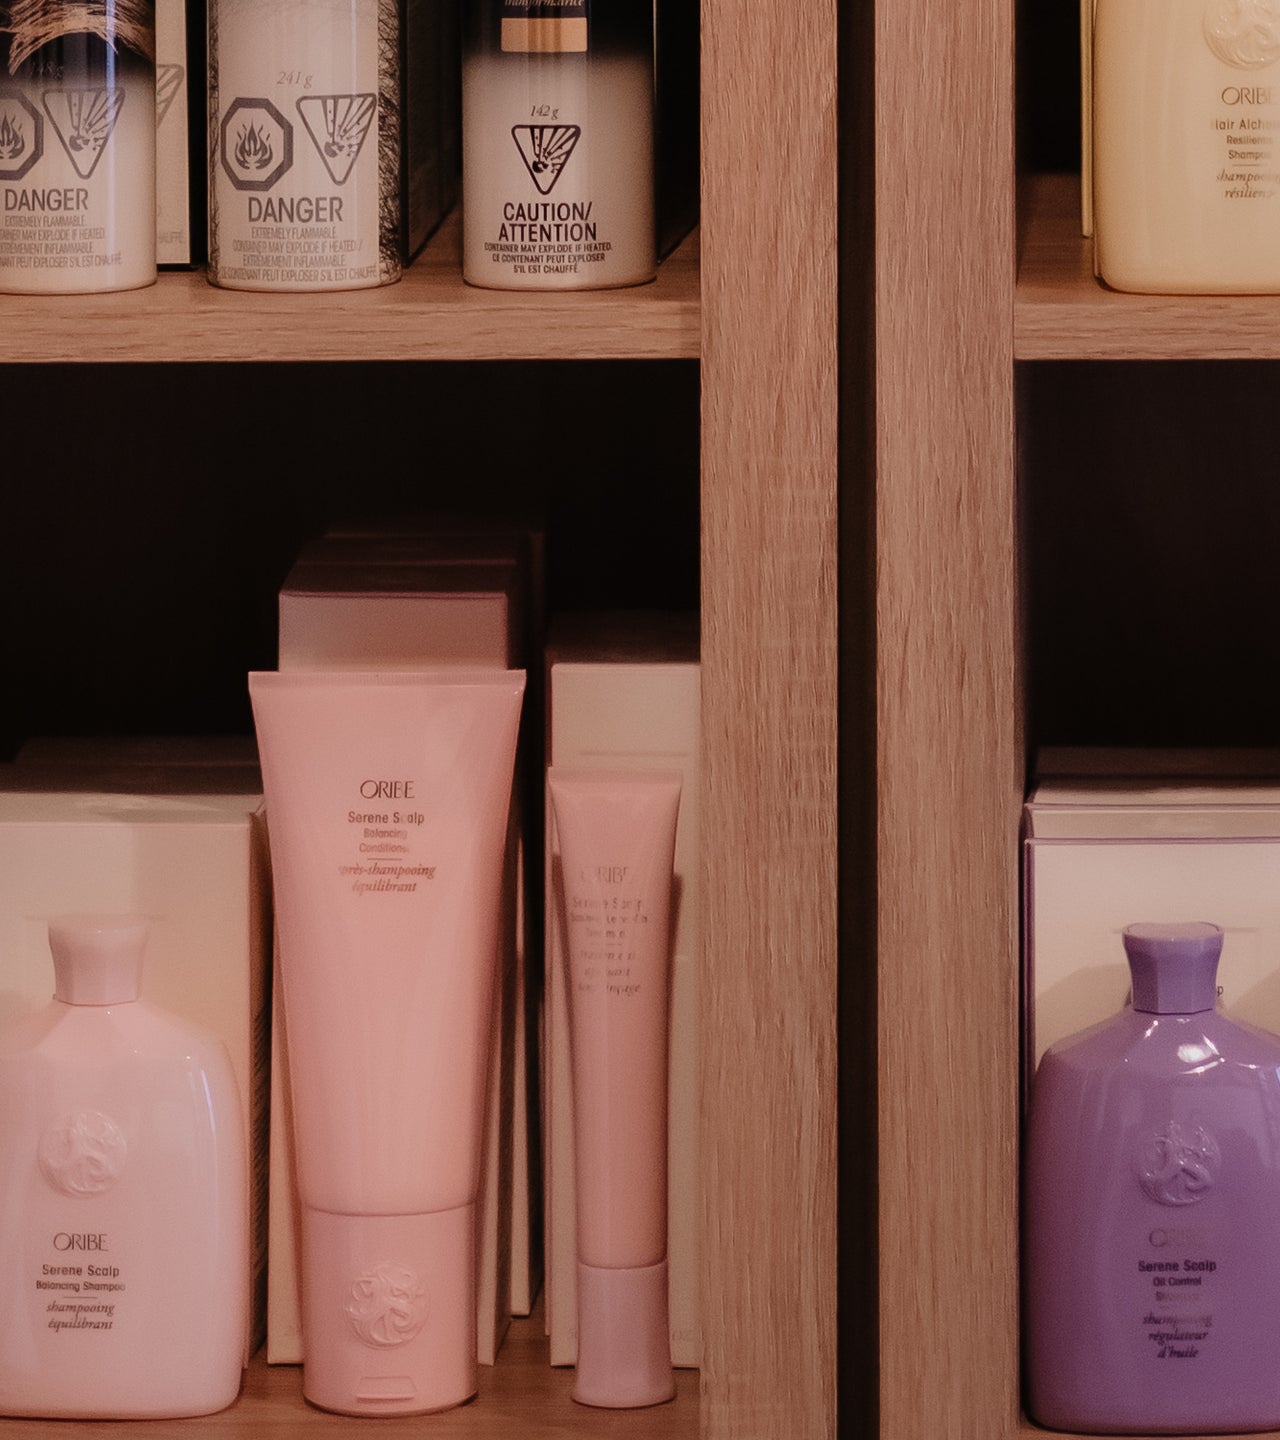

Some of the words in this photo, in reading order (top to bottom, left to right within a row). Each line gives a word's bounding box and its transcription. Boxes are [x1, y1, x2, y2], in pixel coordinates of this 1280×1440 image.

[276, 71, 302, 85] 241
[303, 74, 314, 89] g
[529, 104, 552, 118] 142
[551, 107, 560, 121] g
[4, 187, 90, 212] DANGER
[248, 196, 344, 223] DANGER
[503, 201, 593, 222] CAUTION/
[498, 222, 598, 243] ATTENTION
[360, 779, 416, 799] ORIBE
[348, 810, 390, 824] Serene
[53, 1232, 110, 1253] ORIBE
[42, 1263, 83, 1277] Serene
[87, 1264, 121, 1279] Scalp
[1138, 1260, 1180, 1273] Serene
[1183, 1259, 1218, 1274] Scalp
[35, 1280, 81, 1293] Balancing
[82, 1281, 127, 1293] Shampoo
[1152, 1275, 1167, 1288] Oil
[1168, 1276, 1203, 1287] Control
[46, 1299, 115, 1318] shampooing
[47, 1317, 114, 1334] équilibrant
